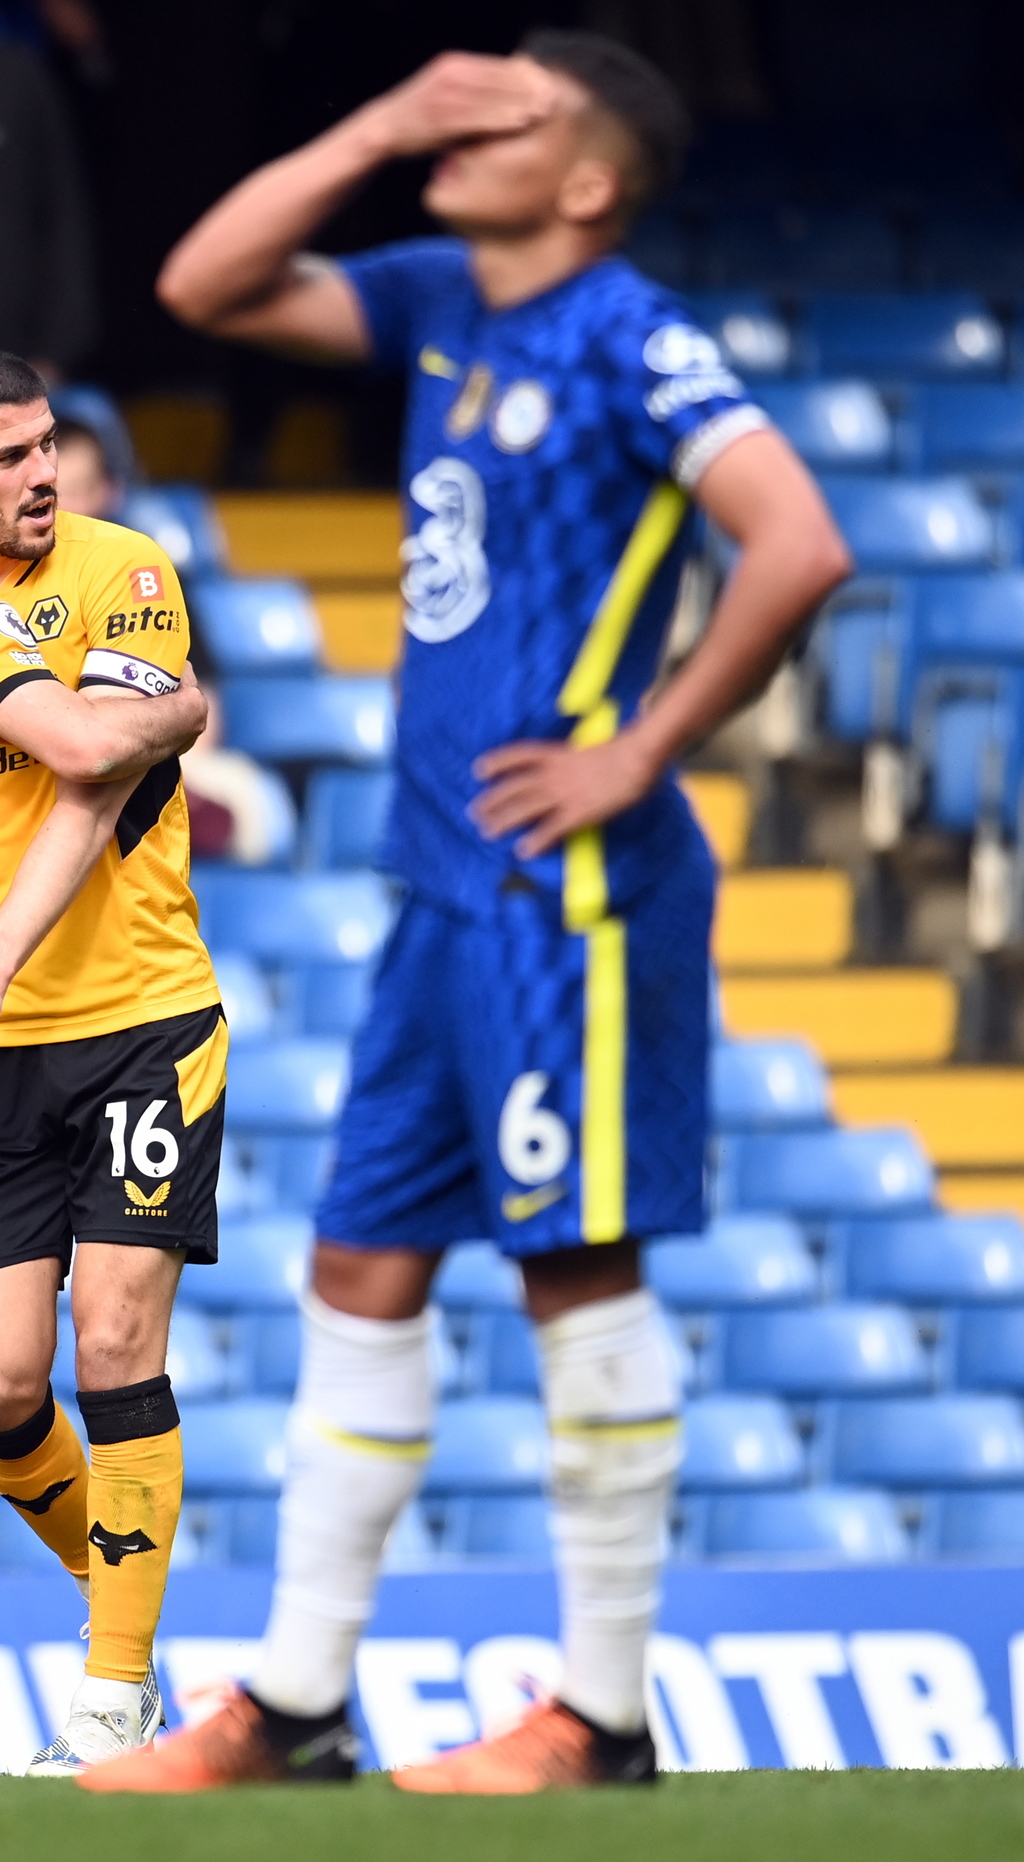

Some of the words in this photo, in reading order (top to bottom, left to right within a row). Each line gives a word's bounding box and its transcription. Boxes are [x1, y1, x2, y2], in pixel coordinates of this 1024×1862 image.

[106, 606, 173, 639] Bitci
[104, 1099, 179, 1178] 16
[497, 1069, 573, 1186] 6
[124, 1208, 168, 1217] CASTORE
